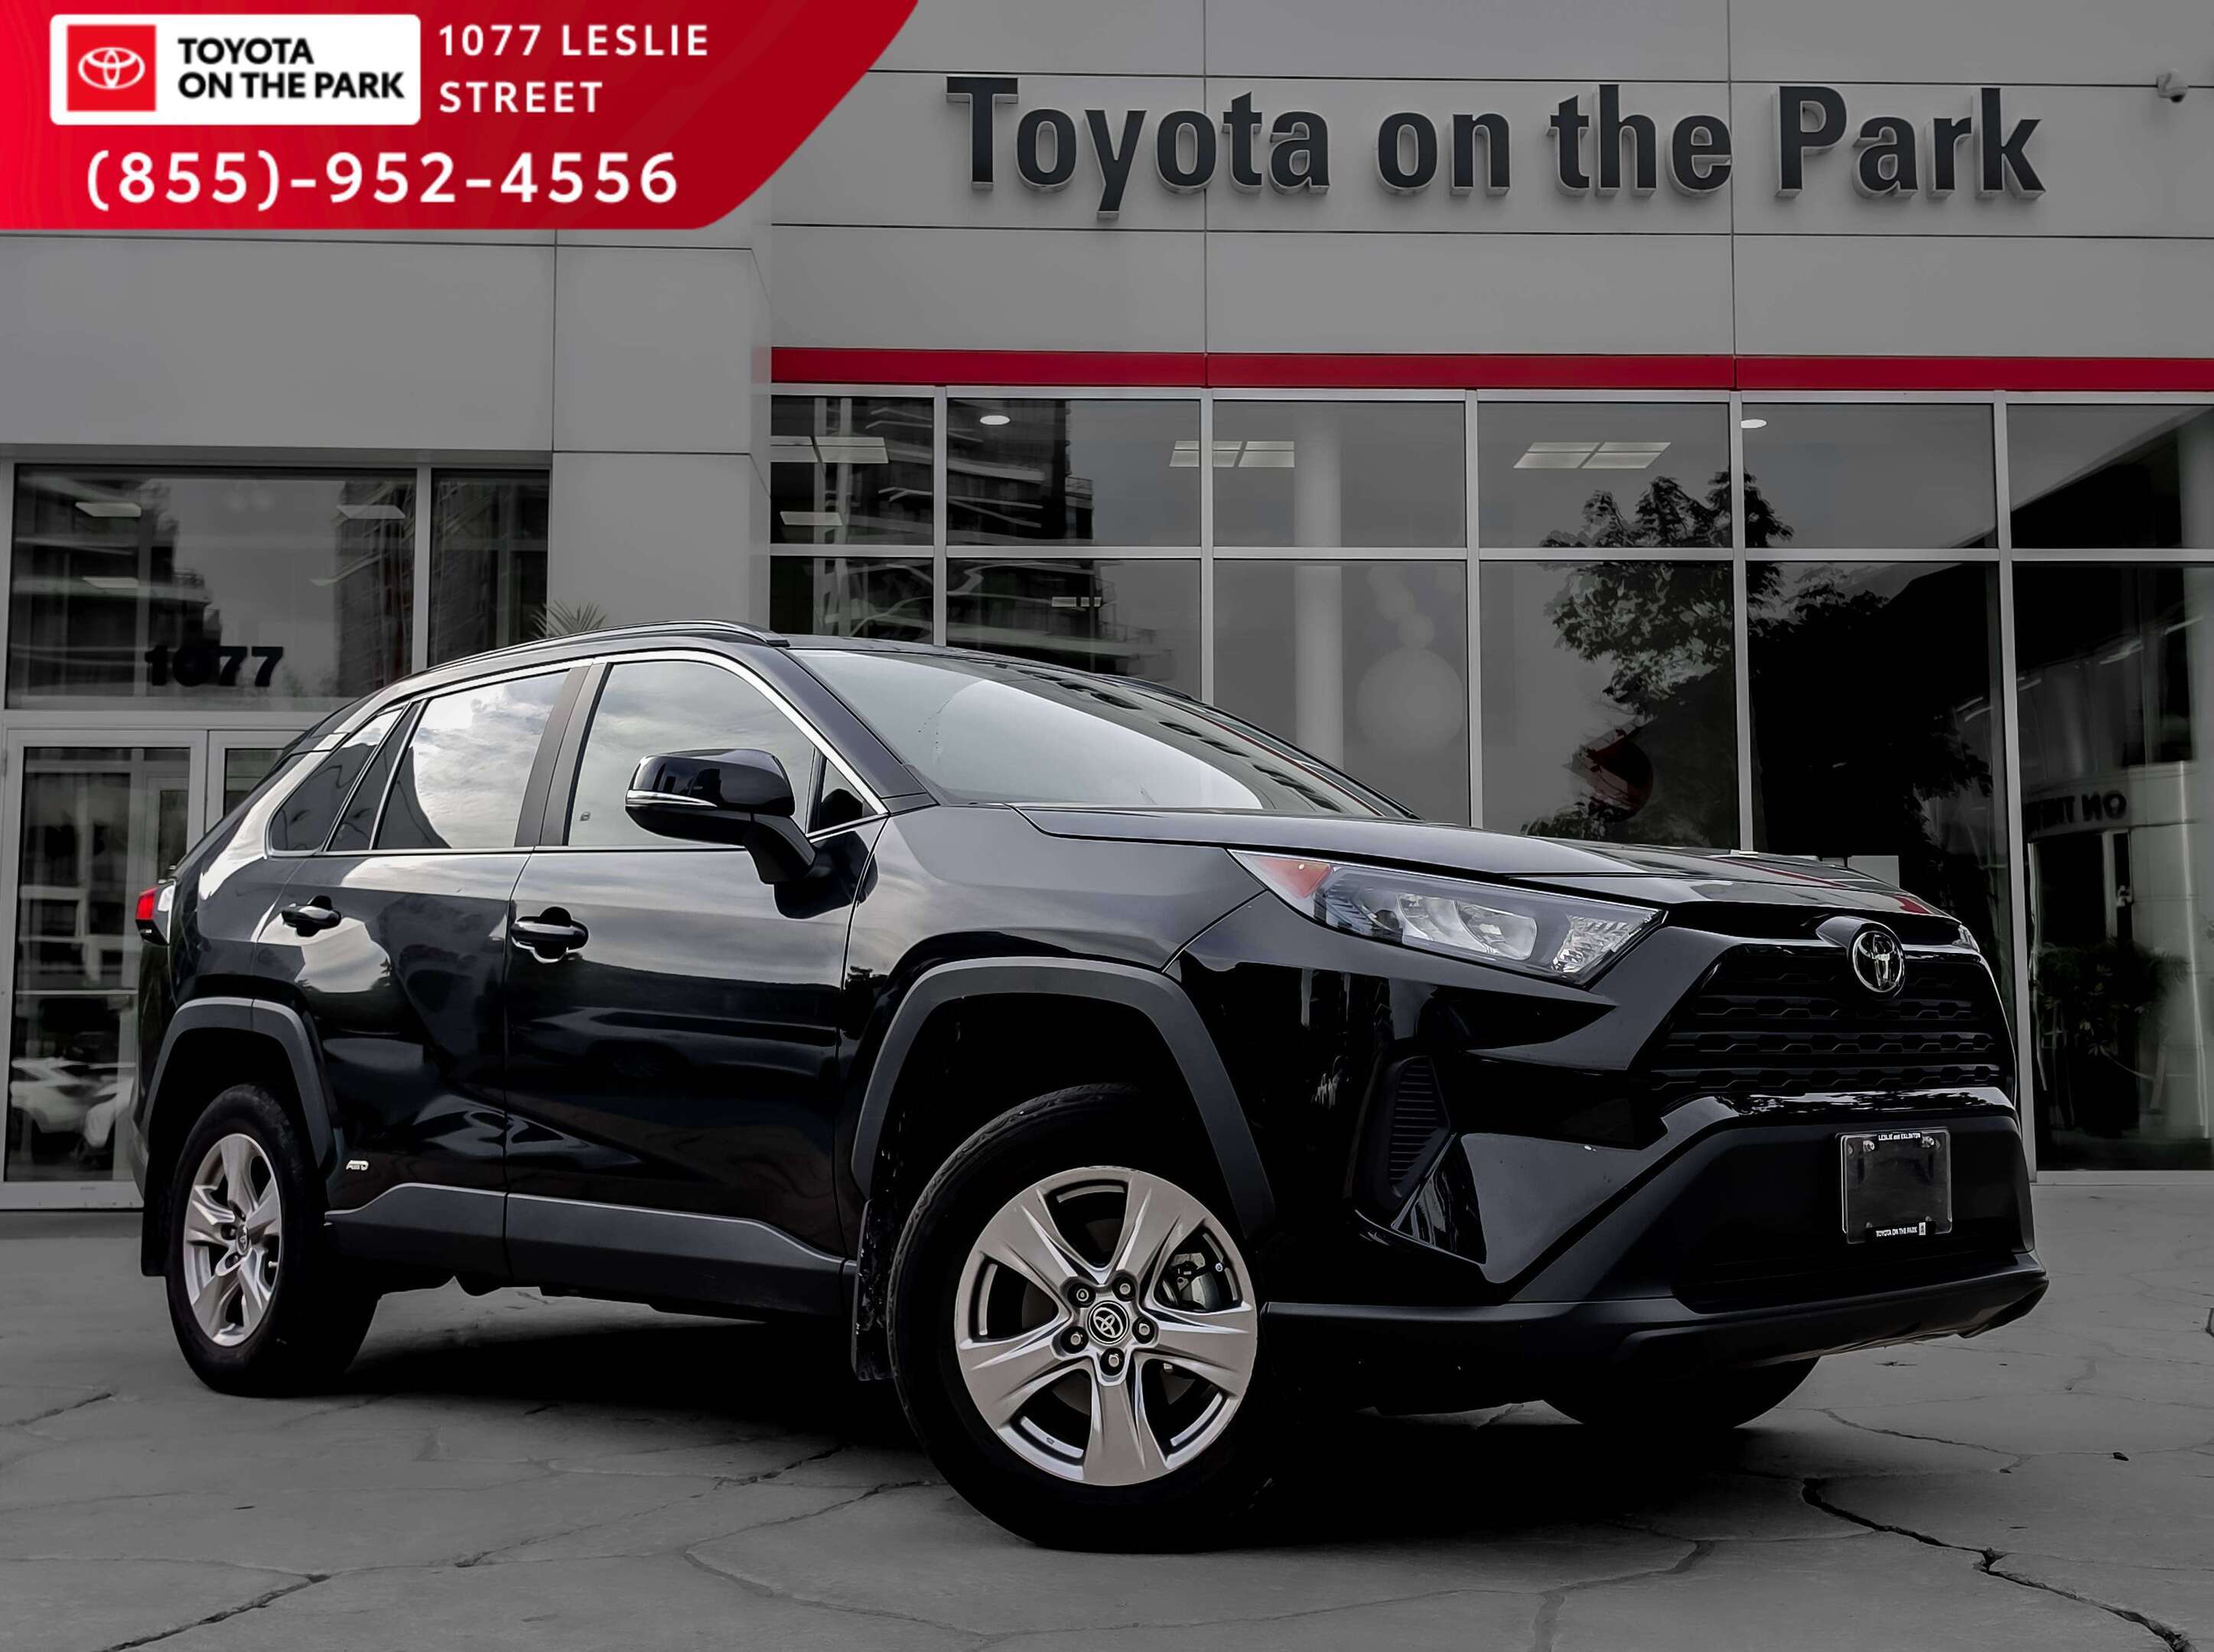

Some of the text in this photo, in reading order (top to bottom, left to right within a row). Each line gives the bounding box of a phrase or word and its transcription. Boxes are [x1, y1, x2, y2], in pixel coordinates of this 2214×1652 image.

[946, 76, 2046, 220] Toyota on the Park
[145, 645, 284, 687] 1077
